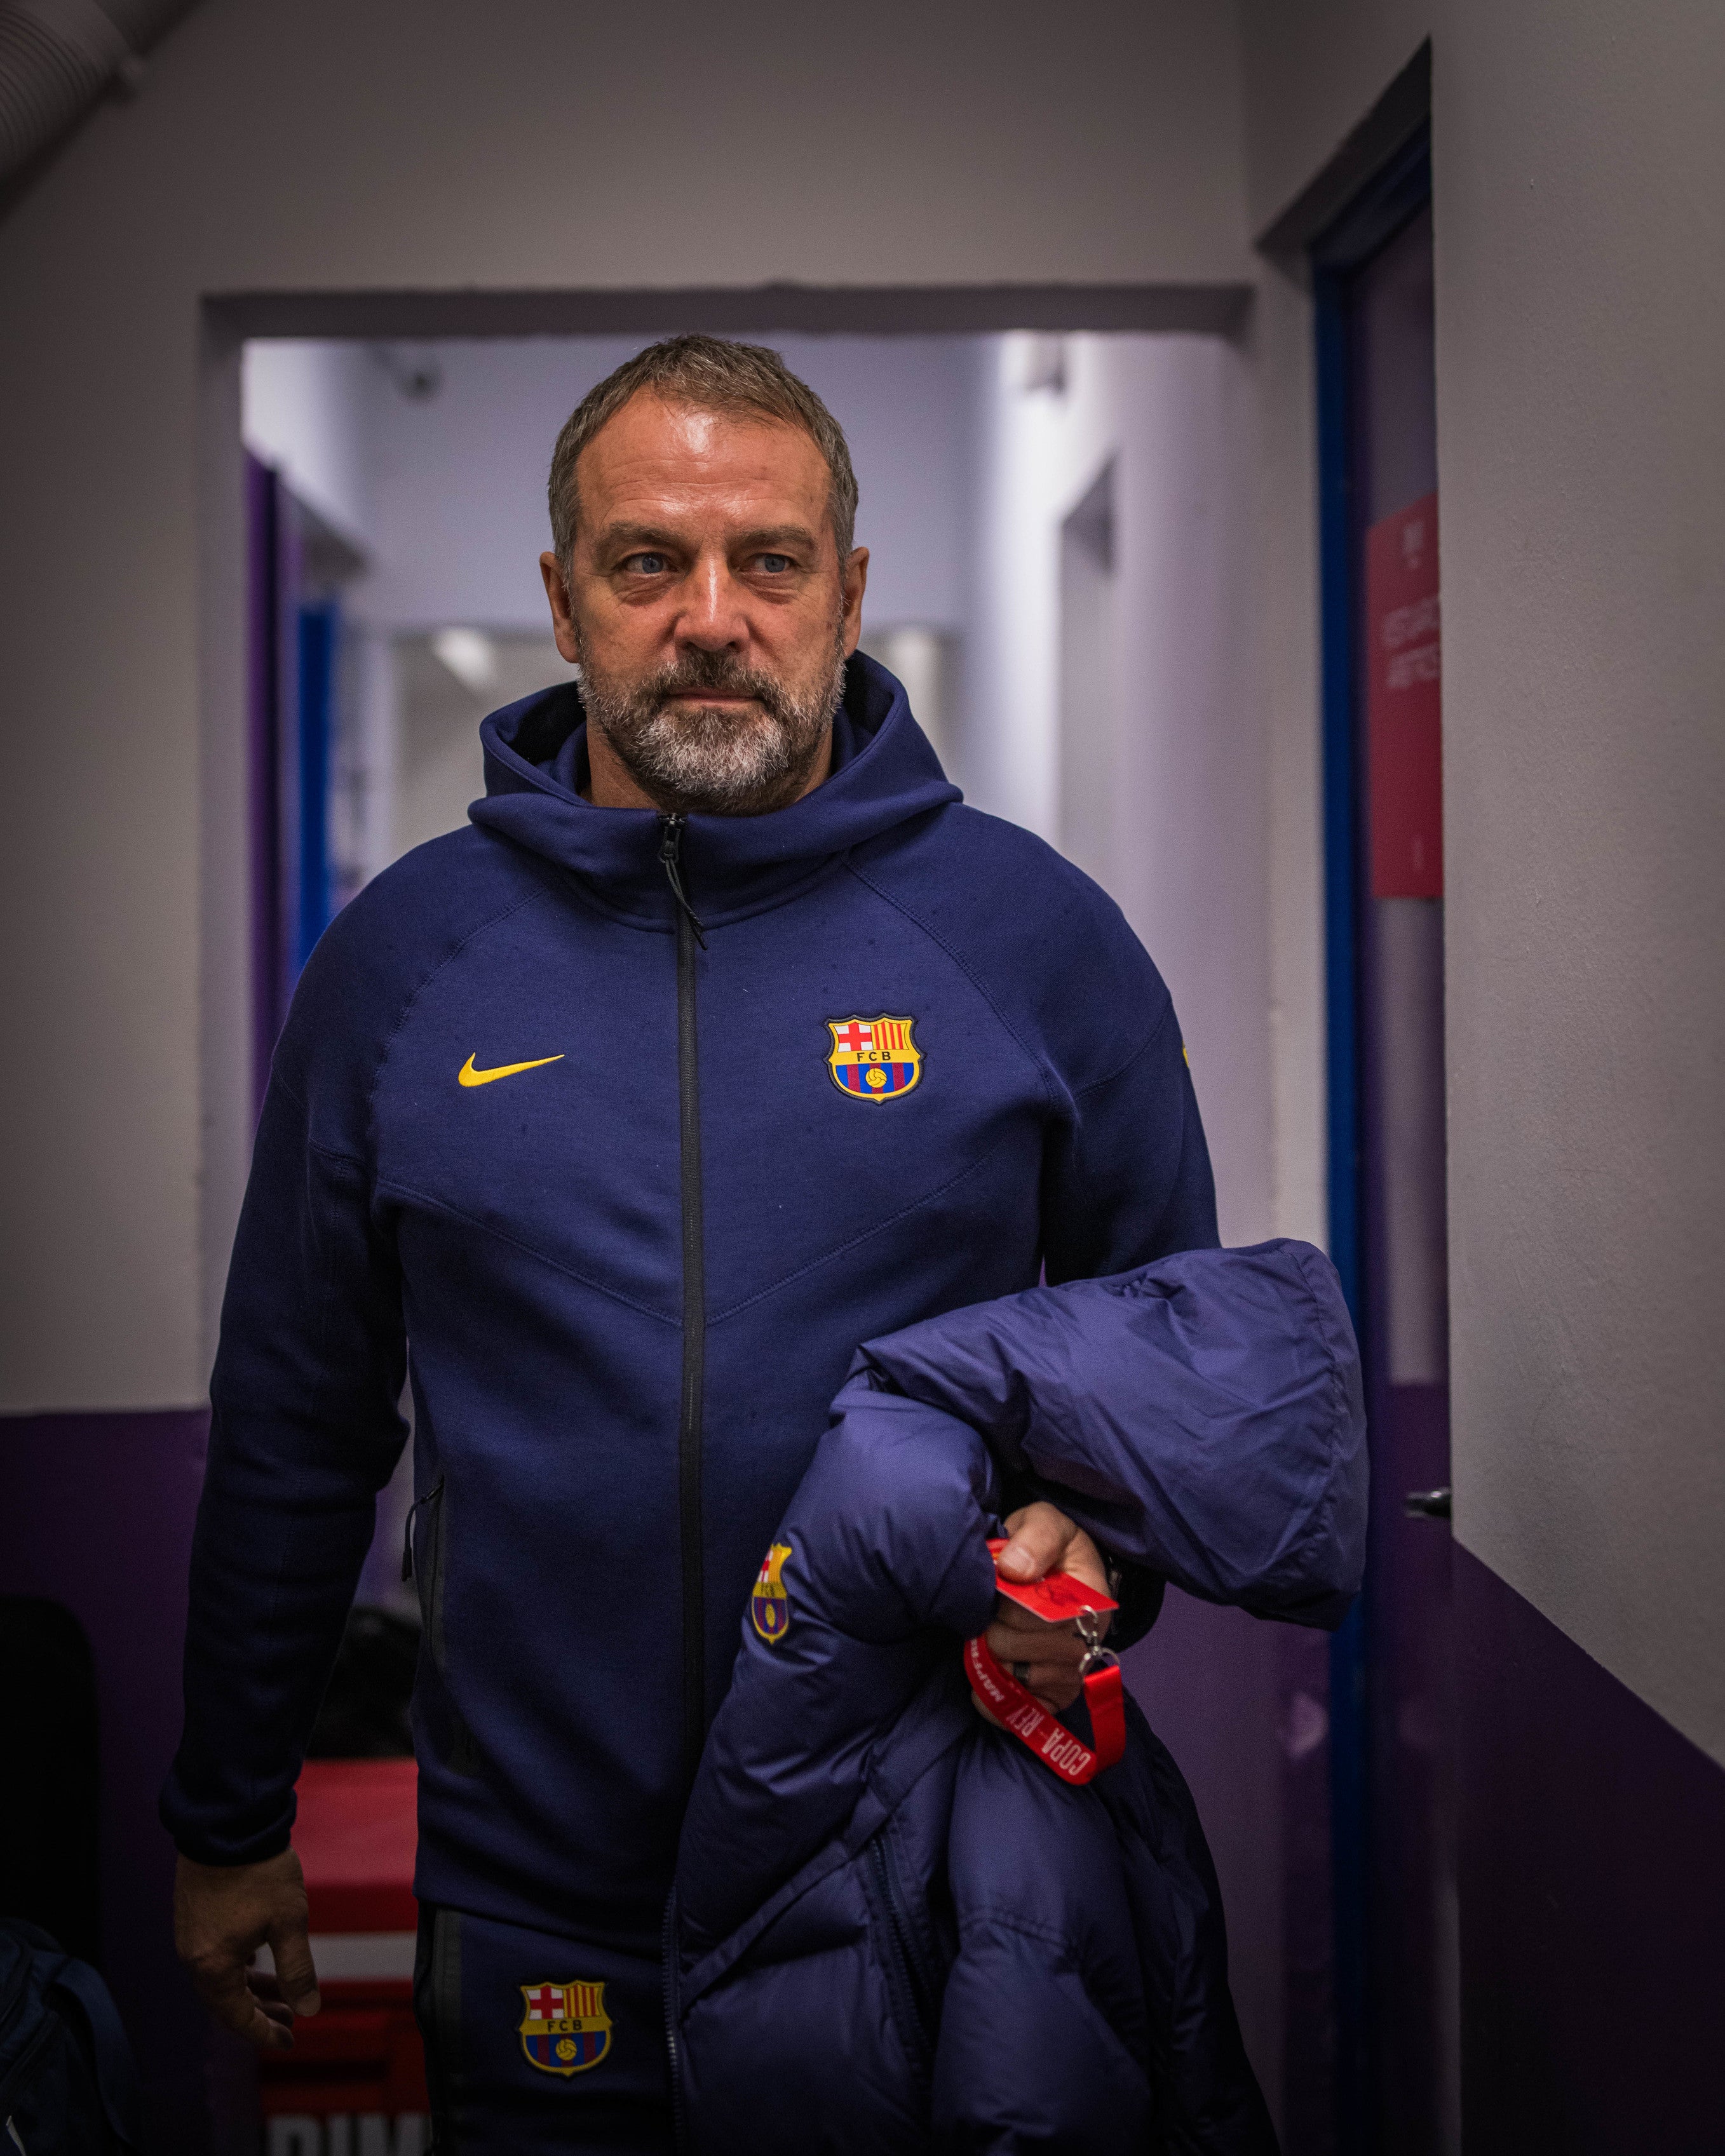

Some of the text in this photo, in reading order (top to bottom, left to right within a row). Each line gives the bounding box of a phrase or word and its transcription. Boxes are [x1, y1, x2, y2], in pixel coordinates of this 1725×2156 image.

[856, 1051, 891, 1062] FCB
[1006, 1704, 1091, 1775] COPA REY
[547, 2019, 583, 2032] FCB
